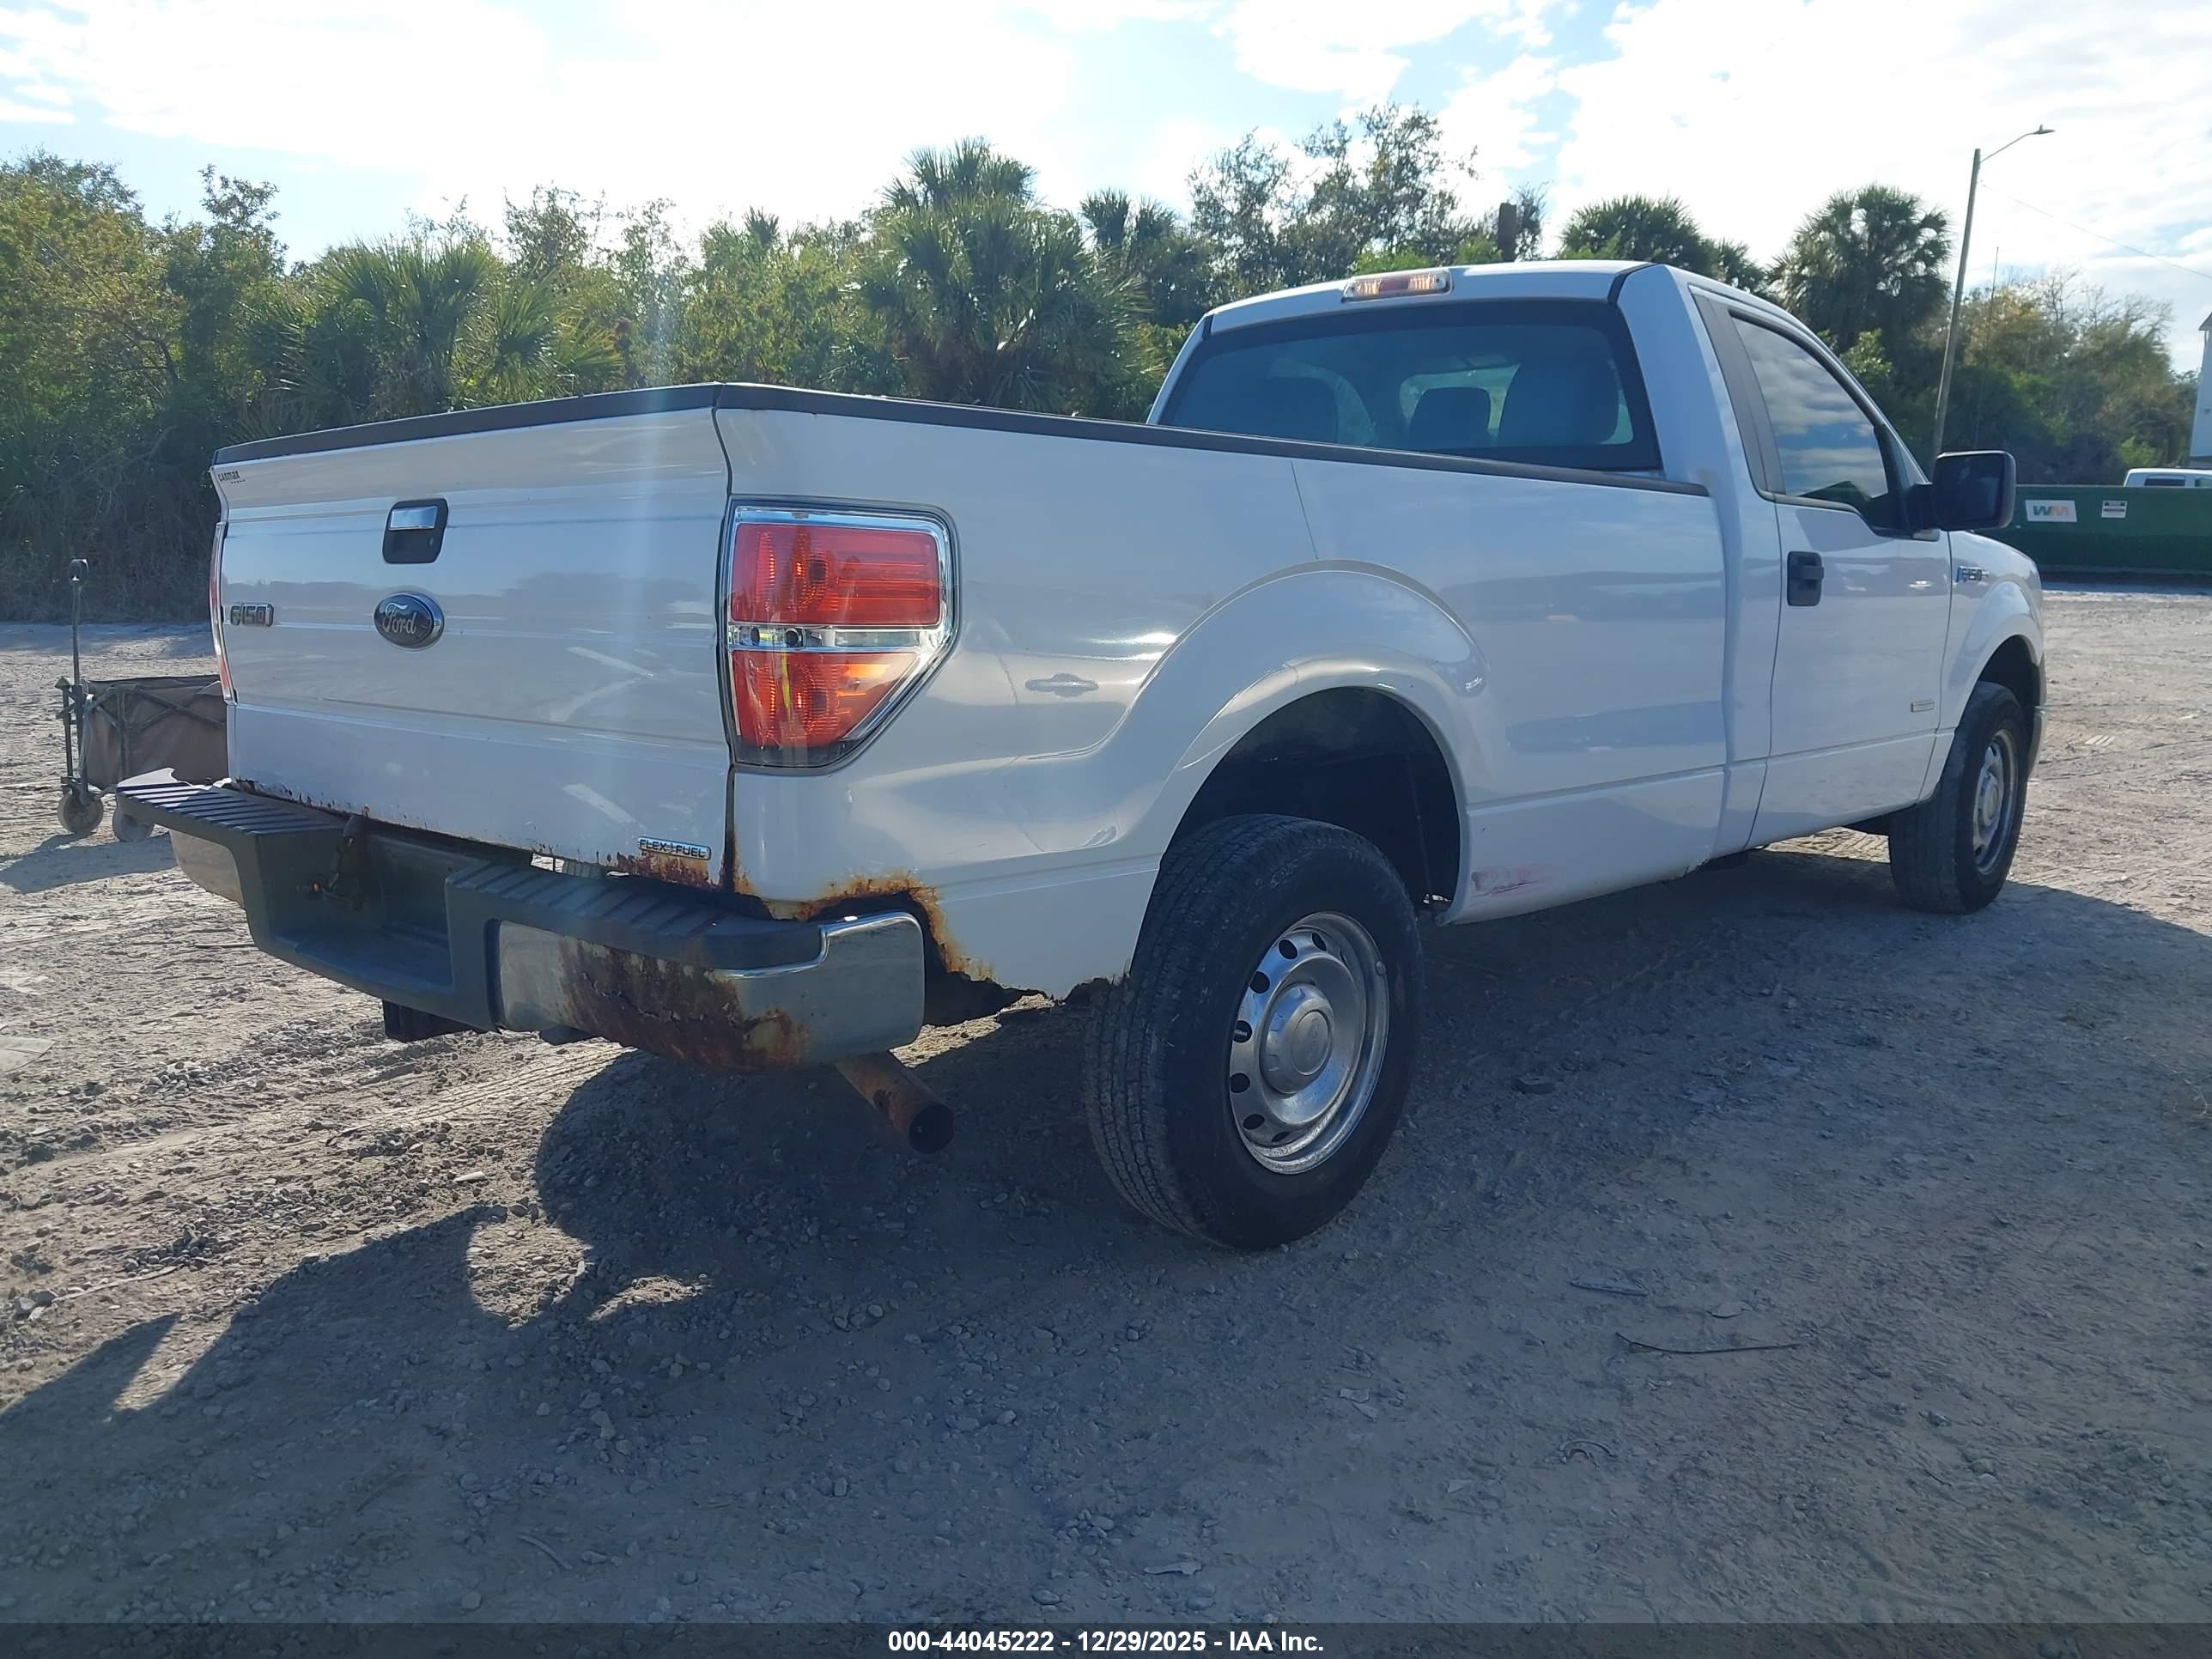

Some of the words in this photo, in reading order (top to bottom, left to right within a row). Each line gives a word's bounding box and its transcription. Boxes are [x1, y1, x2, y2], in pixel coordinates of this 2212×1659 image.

[382, 602, 417, 634] Ford
[640, 839, 667, 852] FLEX
[676, 845, 707, 858] FUEL
